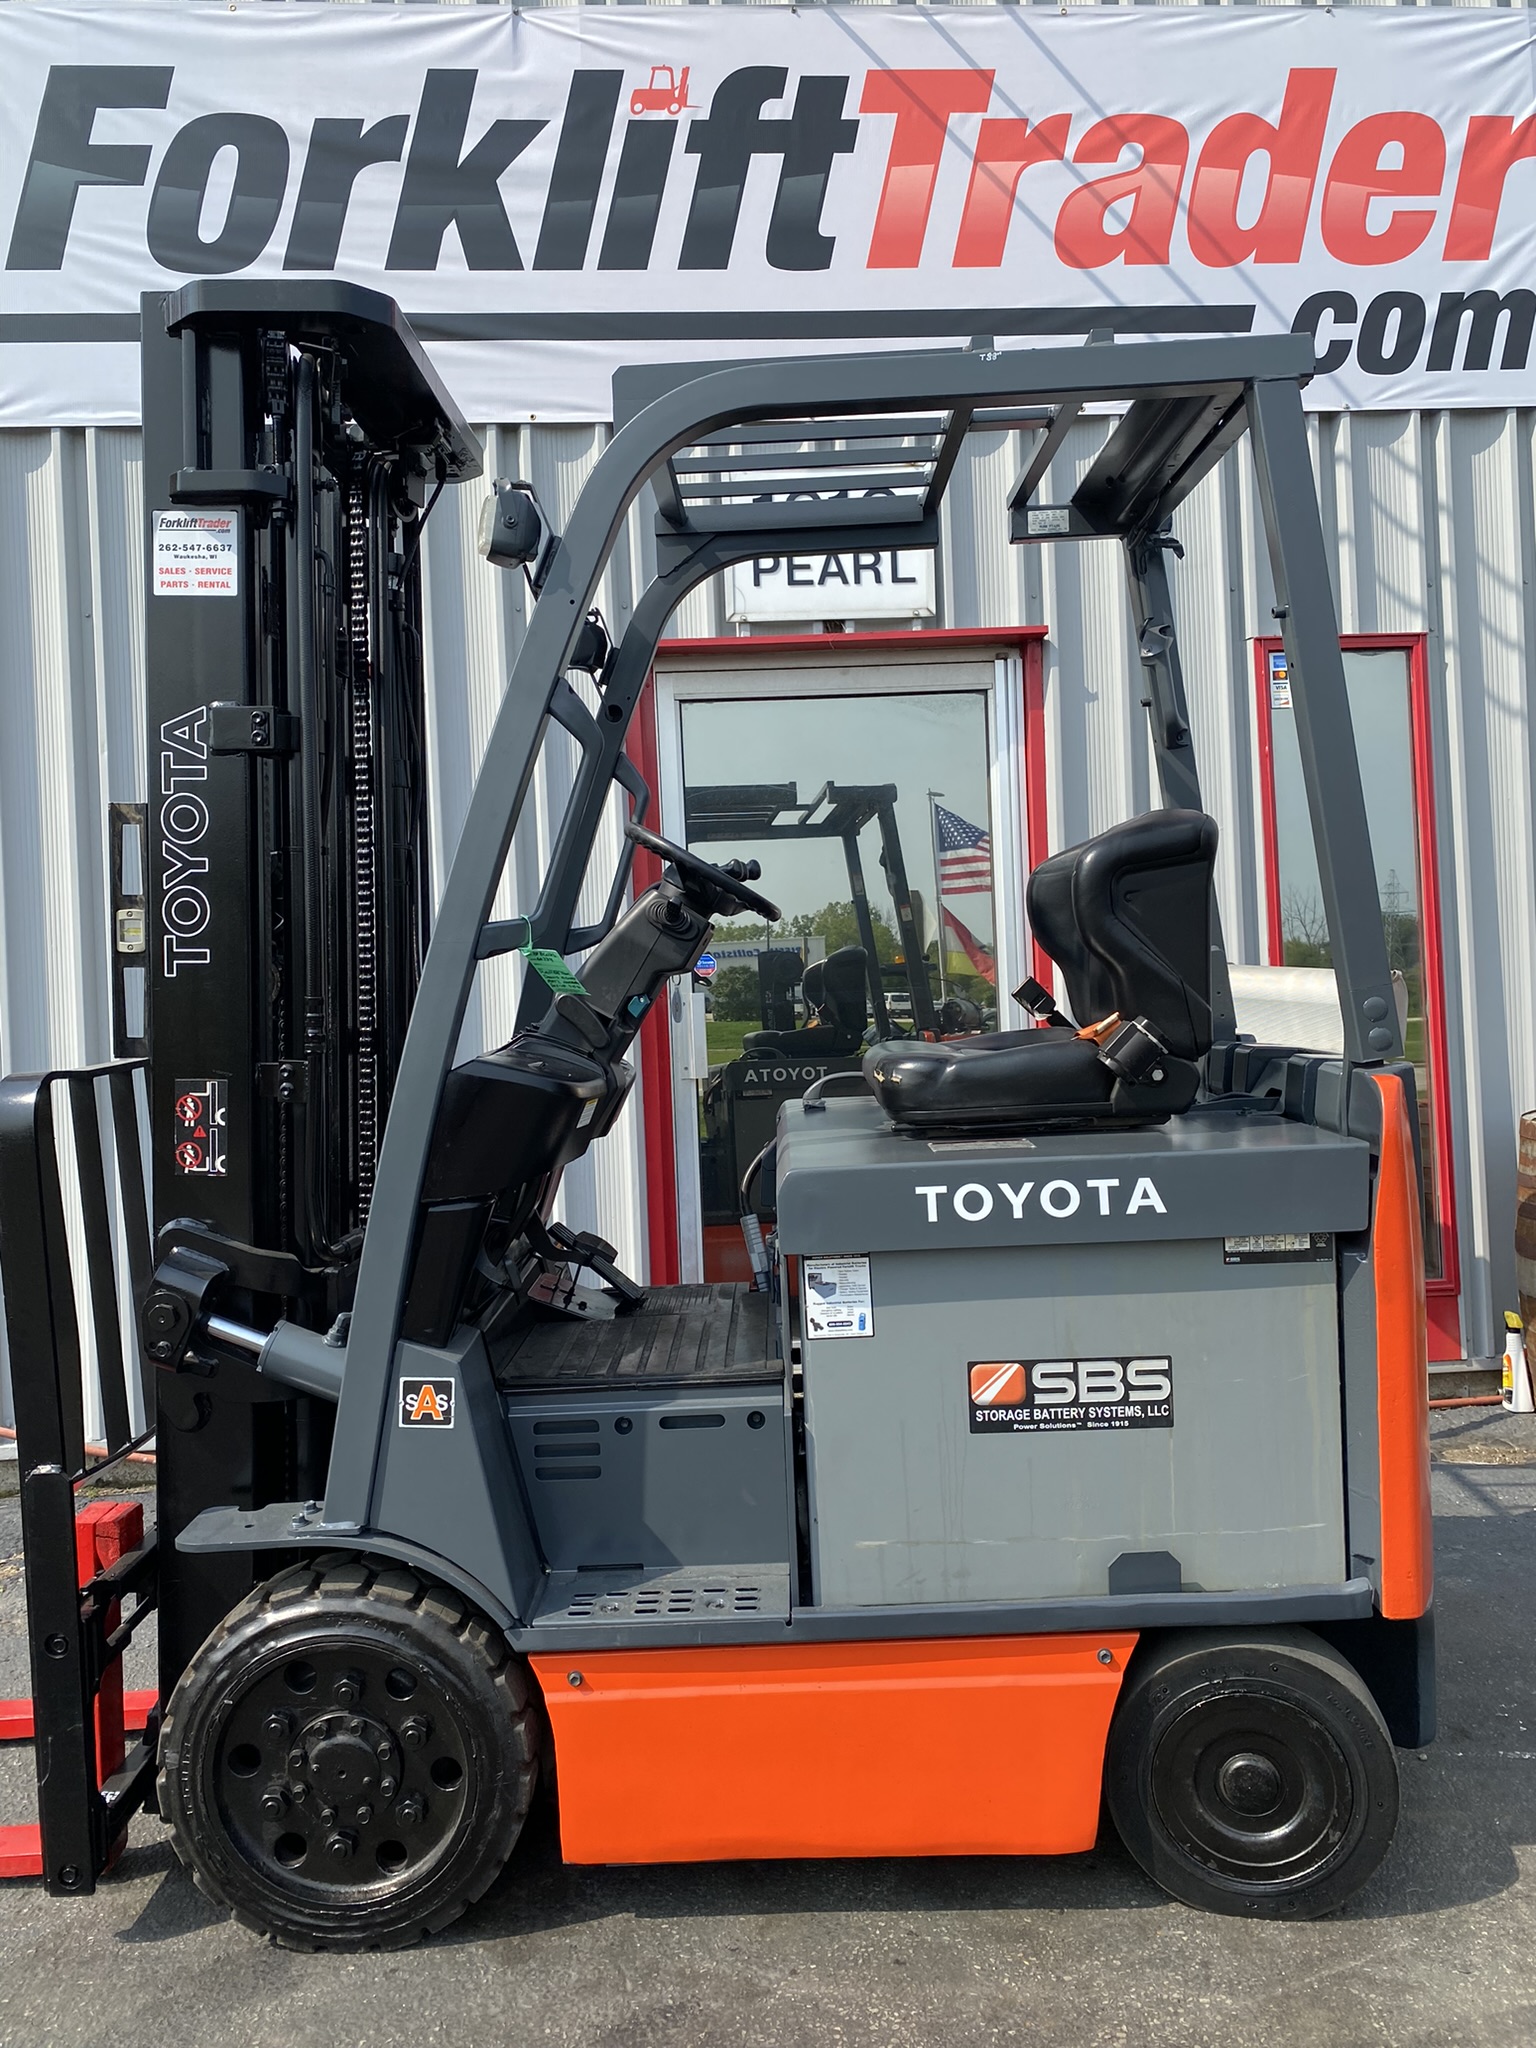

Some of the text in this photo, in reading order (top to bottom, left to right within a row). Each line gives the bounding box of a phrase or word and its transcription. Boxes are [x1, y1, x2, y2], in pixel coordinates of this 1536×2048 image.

[4, 64, 1536, 275] ForkliftTrader
[159, 517, 231, 528] ForkliftTrader
[158, 567, 232, 575] SALES SERVICE
[752, 551, 917, 587] PEARL
[160, 704, 210, 977] TOYOTA
[914, 1177, 1168, 1223] TOYOTA
[1031, 1359, 1171, 1404] SBS
[975, 1404, 1170, 1422] STORAGE BATTERY SYSTEMS, LLC
[1086, 1420, 1109, 1428] Since
